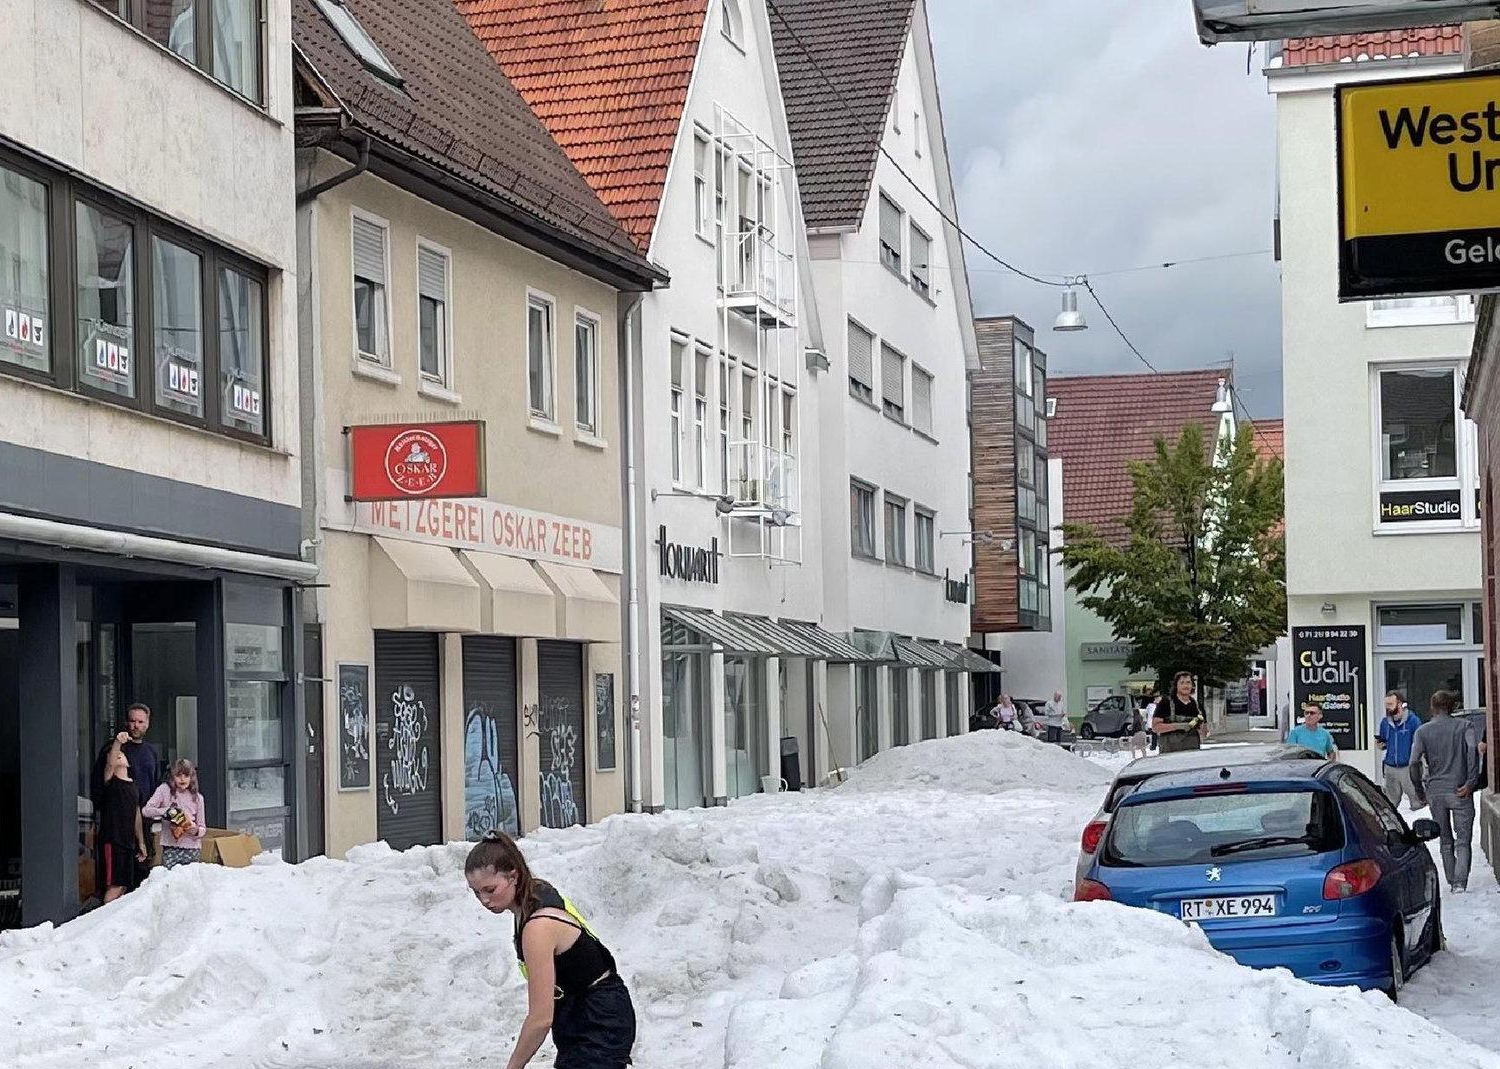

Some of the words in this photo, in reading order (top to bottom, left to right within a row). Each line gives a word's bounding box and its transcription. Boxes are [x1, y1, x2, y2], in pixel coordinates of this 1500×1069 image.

[1379, 101, 1500, 149] West
[1381, 502, 1460, 516] HaarStudio
[371, 499, 485, 544] METZGEREI
[492, 509, 547, 552] OSKAR
[552, 522, 593, 560] ZEEB
[1300, 646, 1337, 667] cut
[1301, 660, 1359, 684] walk
[1182, 901, 1204, 917] RT
[1215, 899, 1237, 916] XE
[1241, 898, 1273, 915] 994
